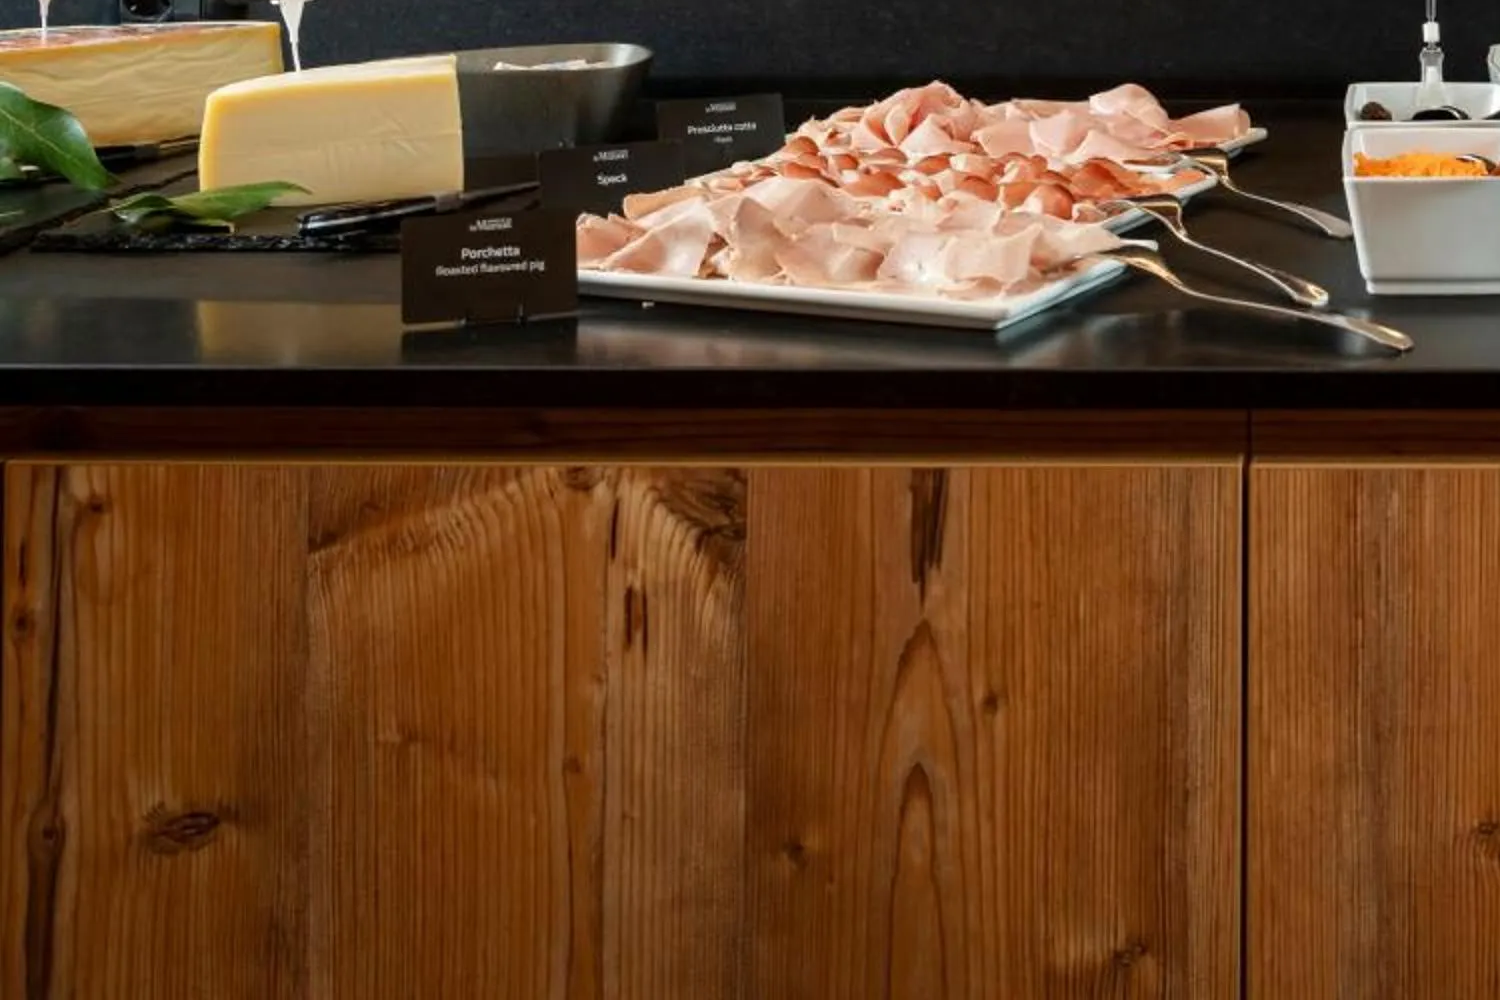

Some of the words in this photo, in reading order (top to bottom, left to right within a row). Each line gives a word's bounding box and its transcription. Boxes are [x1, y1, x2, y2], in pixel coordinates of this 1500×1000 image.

[597, 173, 628, 185] Speck
[460, 246, 521, 259] Porchetta
[529, 260, 545, 273] pig
